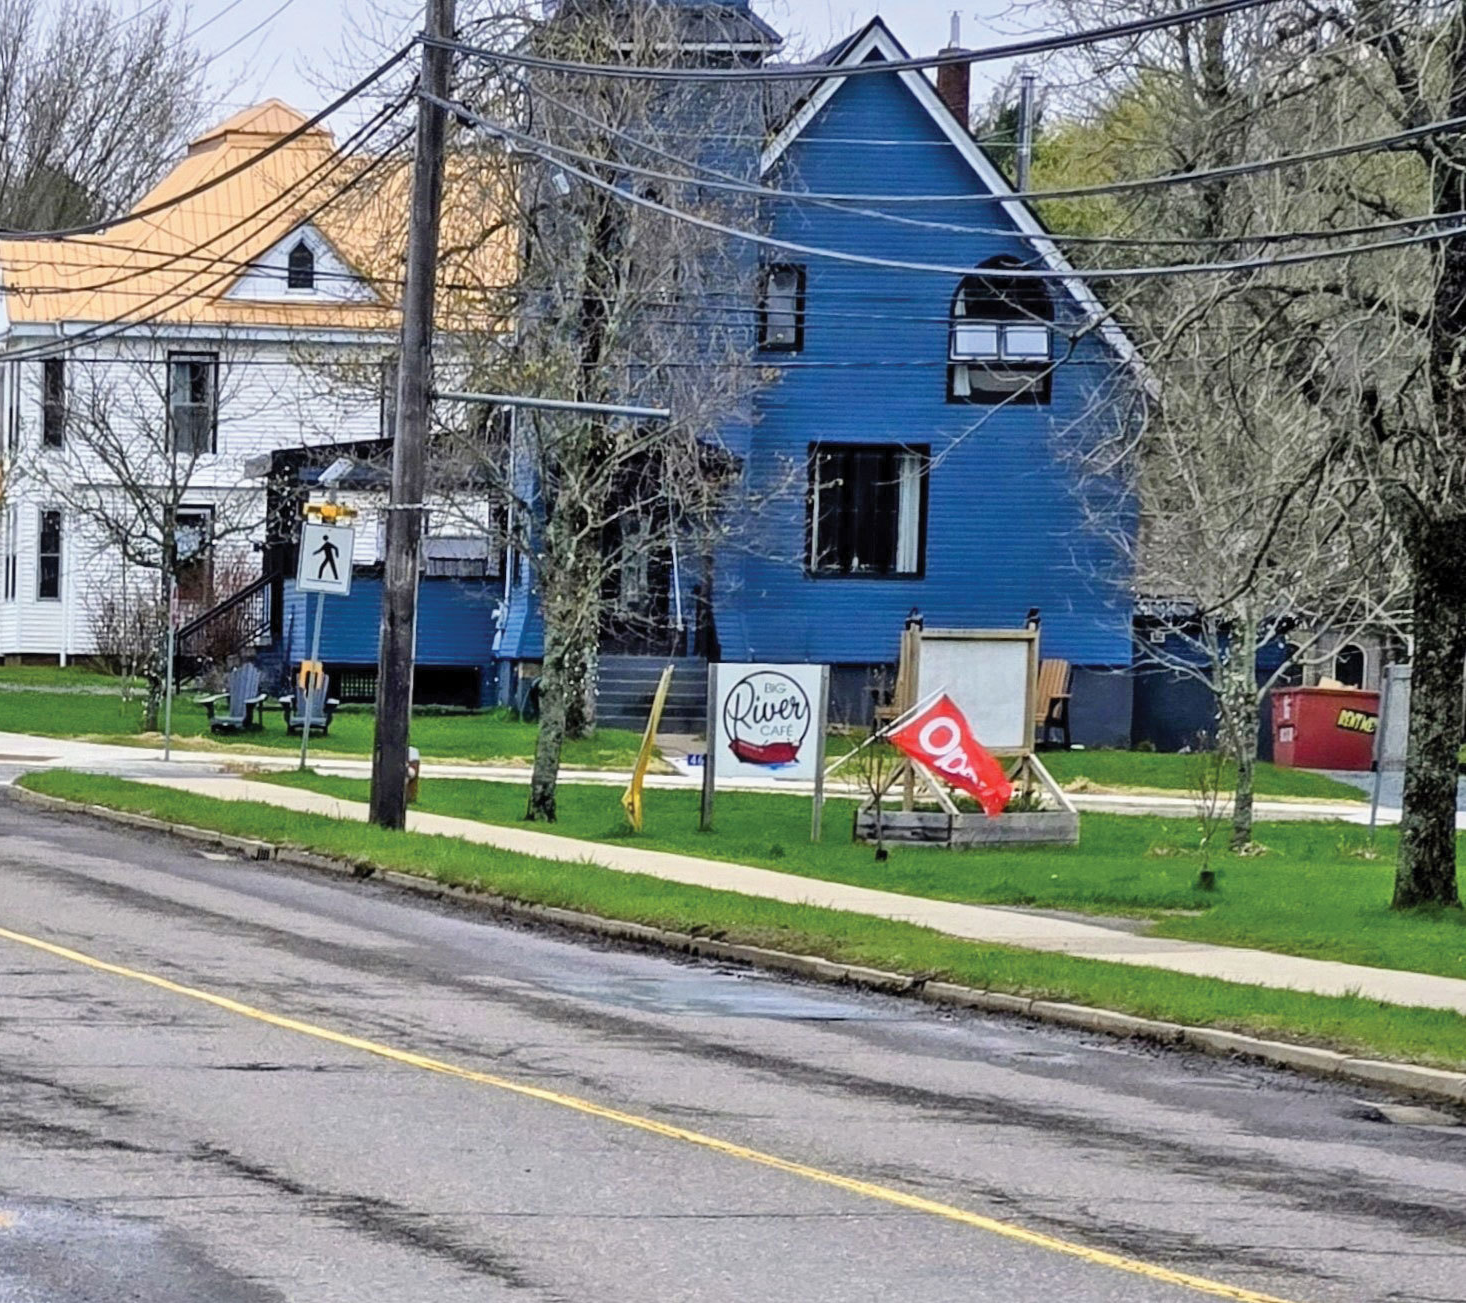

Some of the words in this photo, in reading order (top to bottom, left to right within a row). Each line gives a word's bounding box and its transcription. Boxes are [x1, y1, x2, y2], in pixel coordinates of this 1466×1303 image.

[764, 682, 787, 694] BIG
[727, 681, 806, 730] River
[760, 724, 794, 736] CAFÉ
